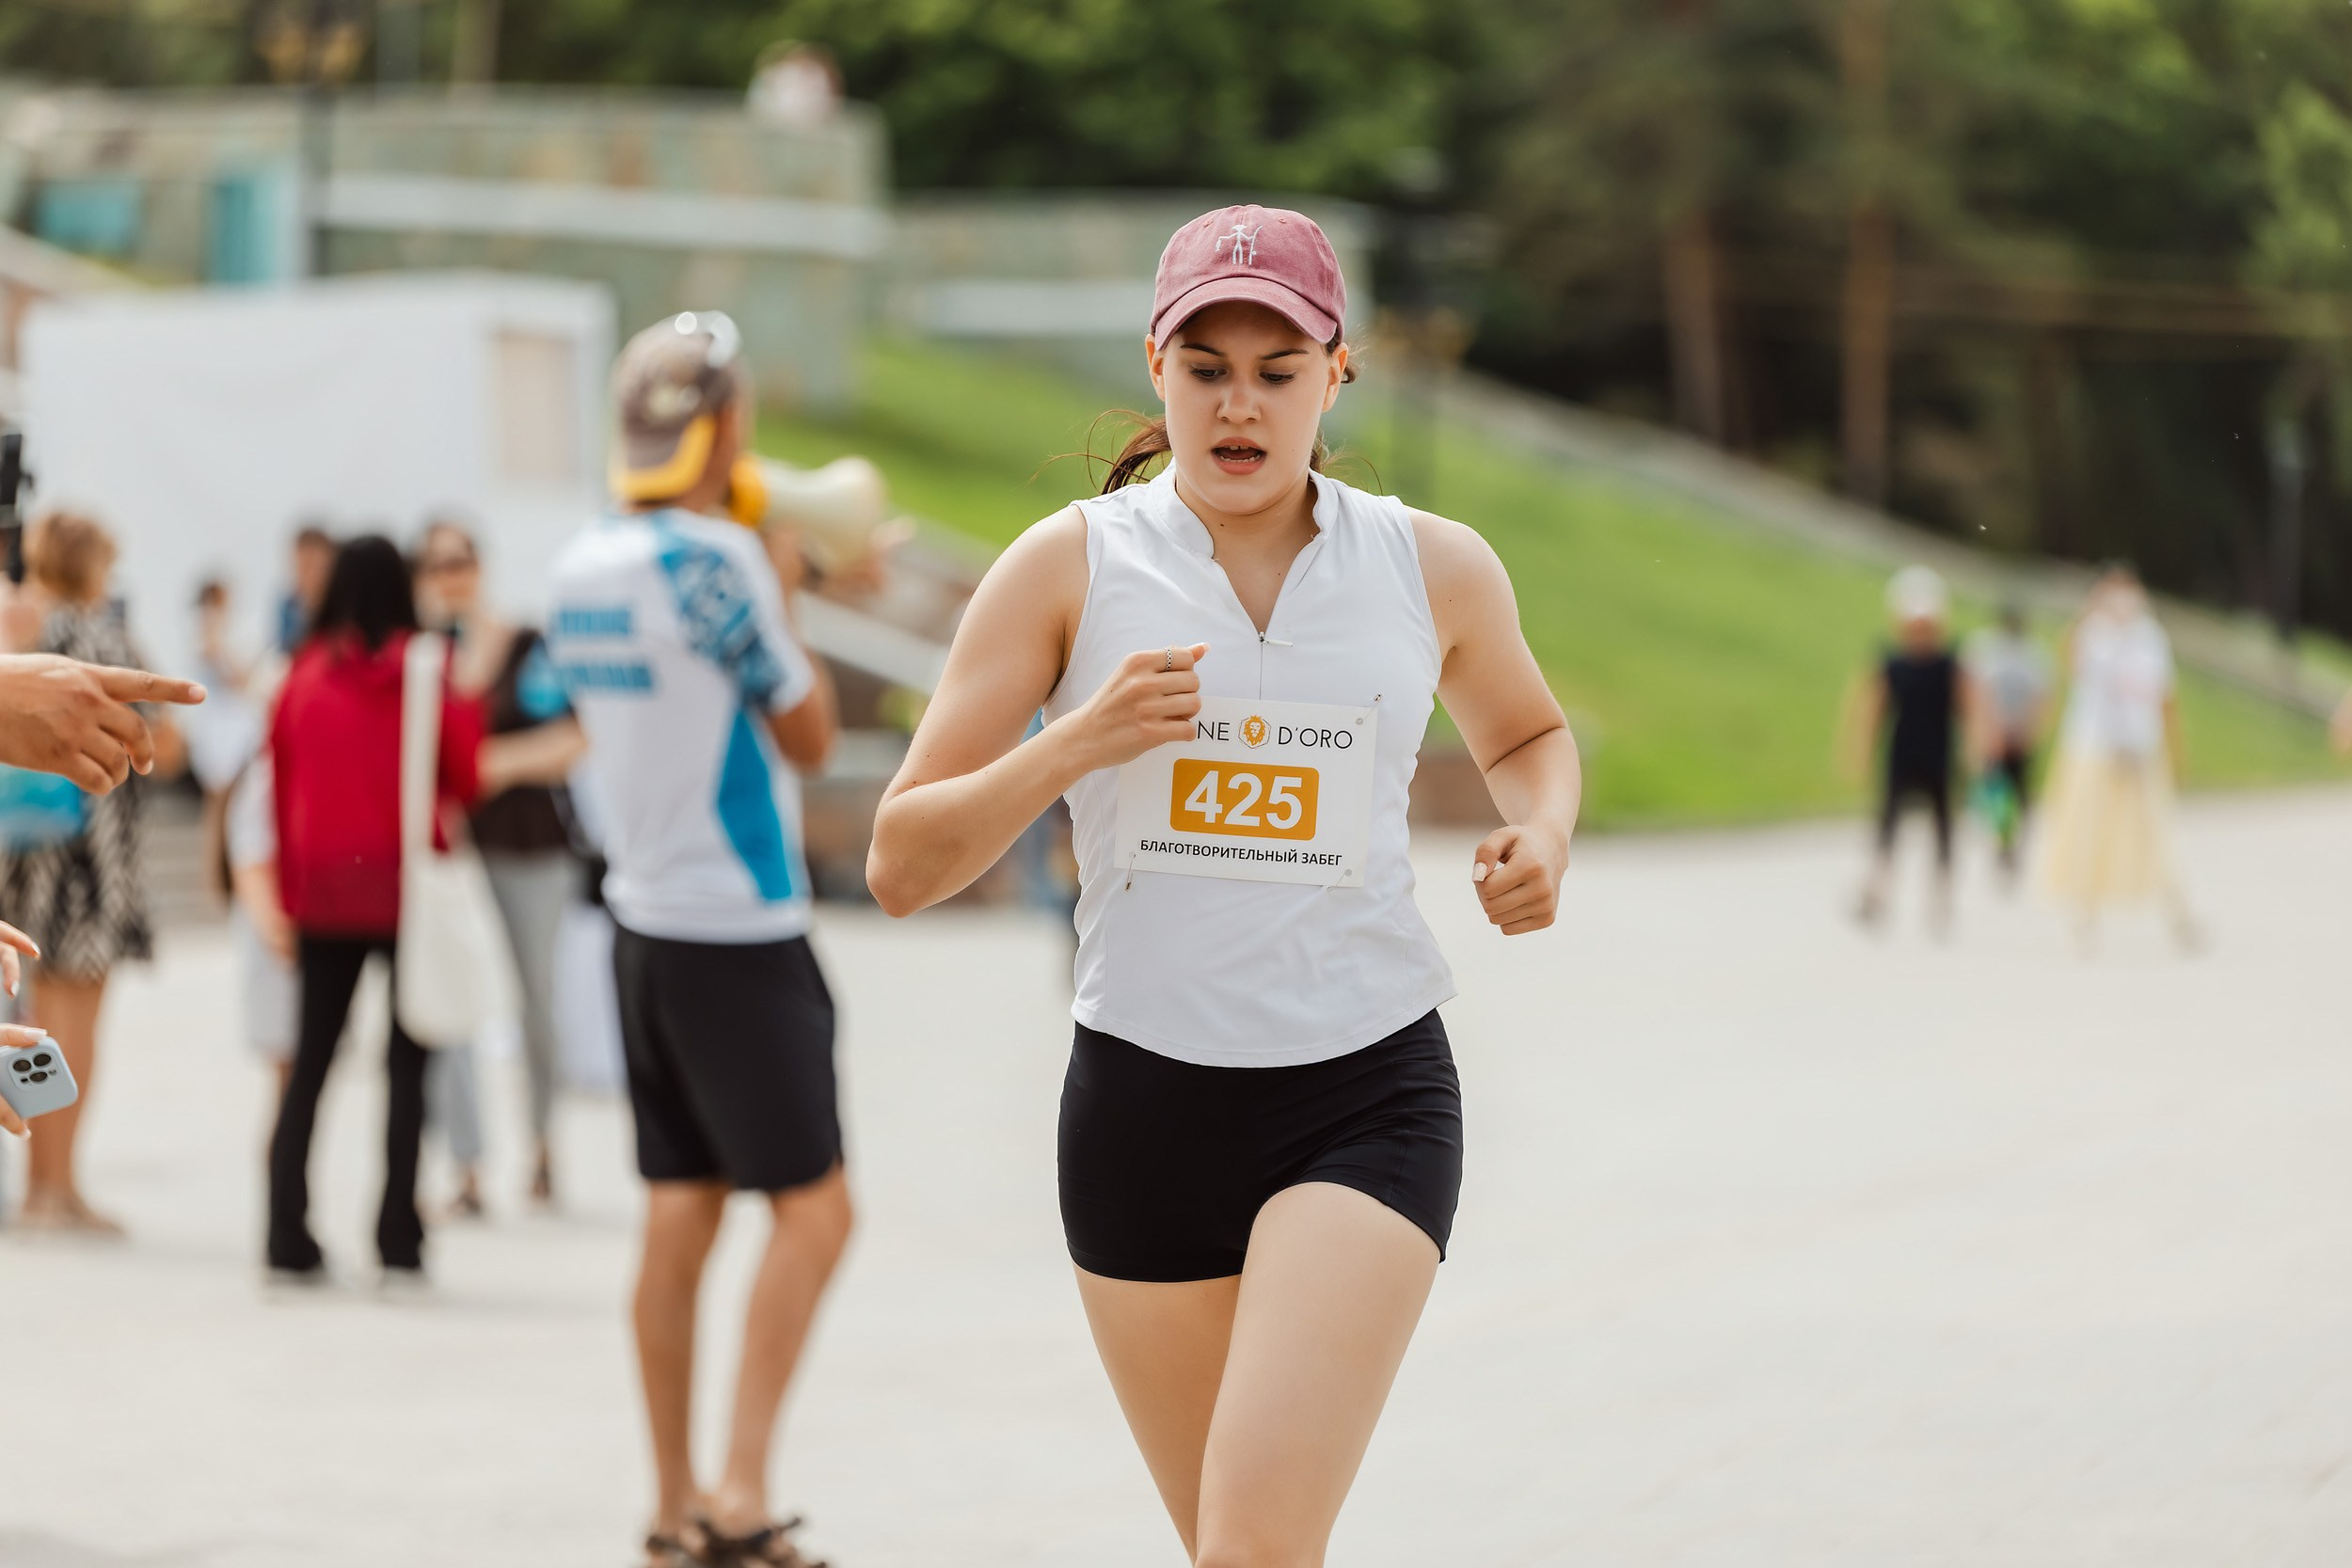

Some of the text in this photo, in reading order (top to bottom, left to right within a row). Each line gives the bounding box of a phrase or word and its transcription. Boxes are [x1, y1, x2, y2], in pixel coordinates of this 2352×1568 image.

[1197, 721, 1353, 749] NE D'ORO
[1184, 769, 1302, 830] 425
[1140, 839, 1343, 866] БЛАГОТВОРИТЕЛЬНЫЙ ЗАБЕГ
